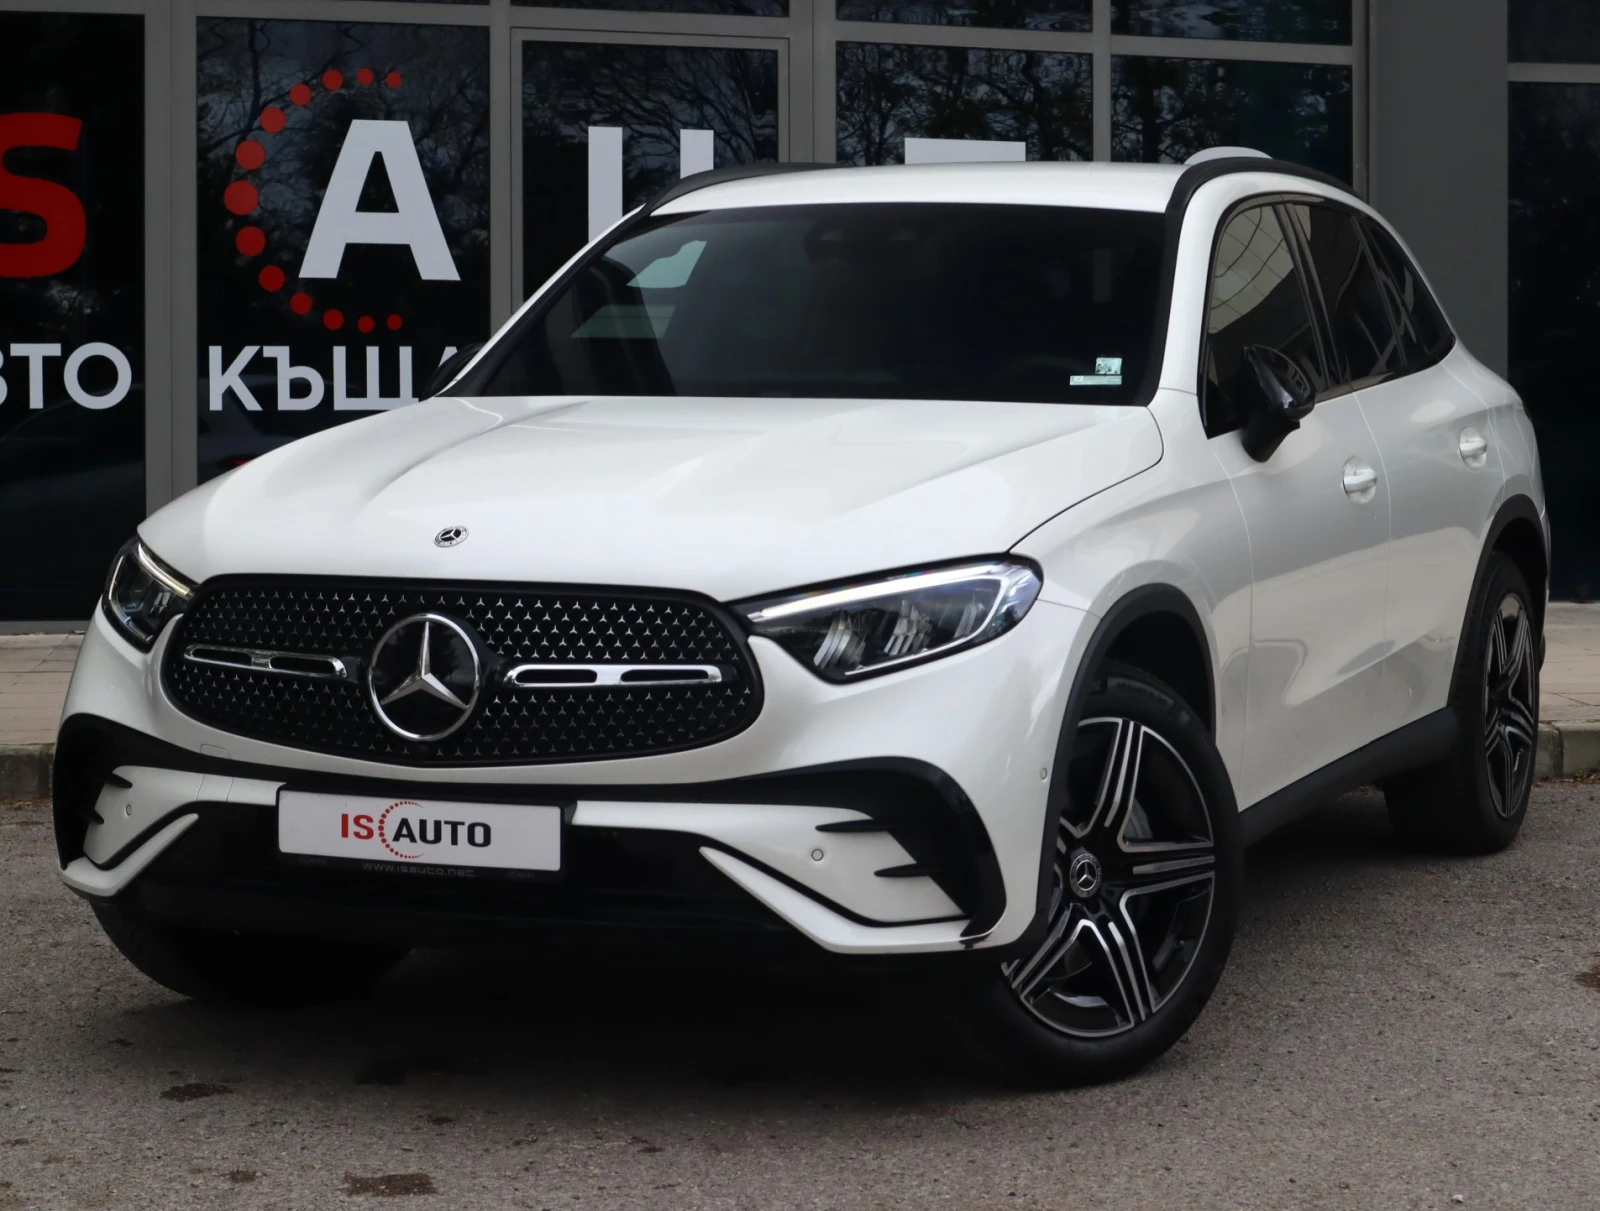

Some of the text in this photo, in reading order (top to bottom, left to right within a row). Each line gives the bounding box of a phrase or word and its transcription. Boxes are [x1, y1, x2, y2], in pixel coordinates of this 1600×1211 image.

[0, 342, 458, 412] ТО КЪЩ
[341, 813, 491, 848] IS AUTO
[362, 861, 476, 878] www.isauto.net
